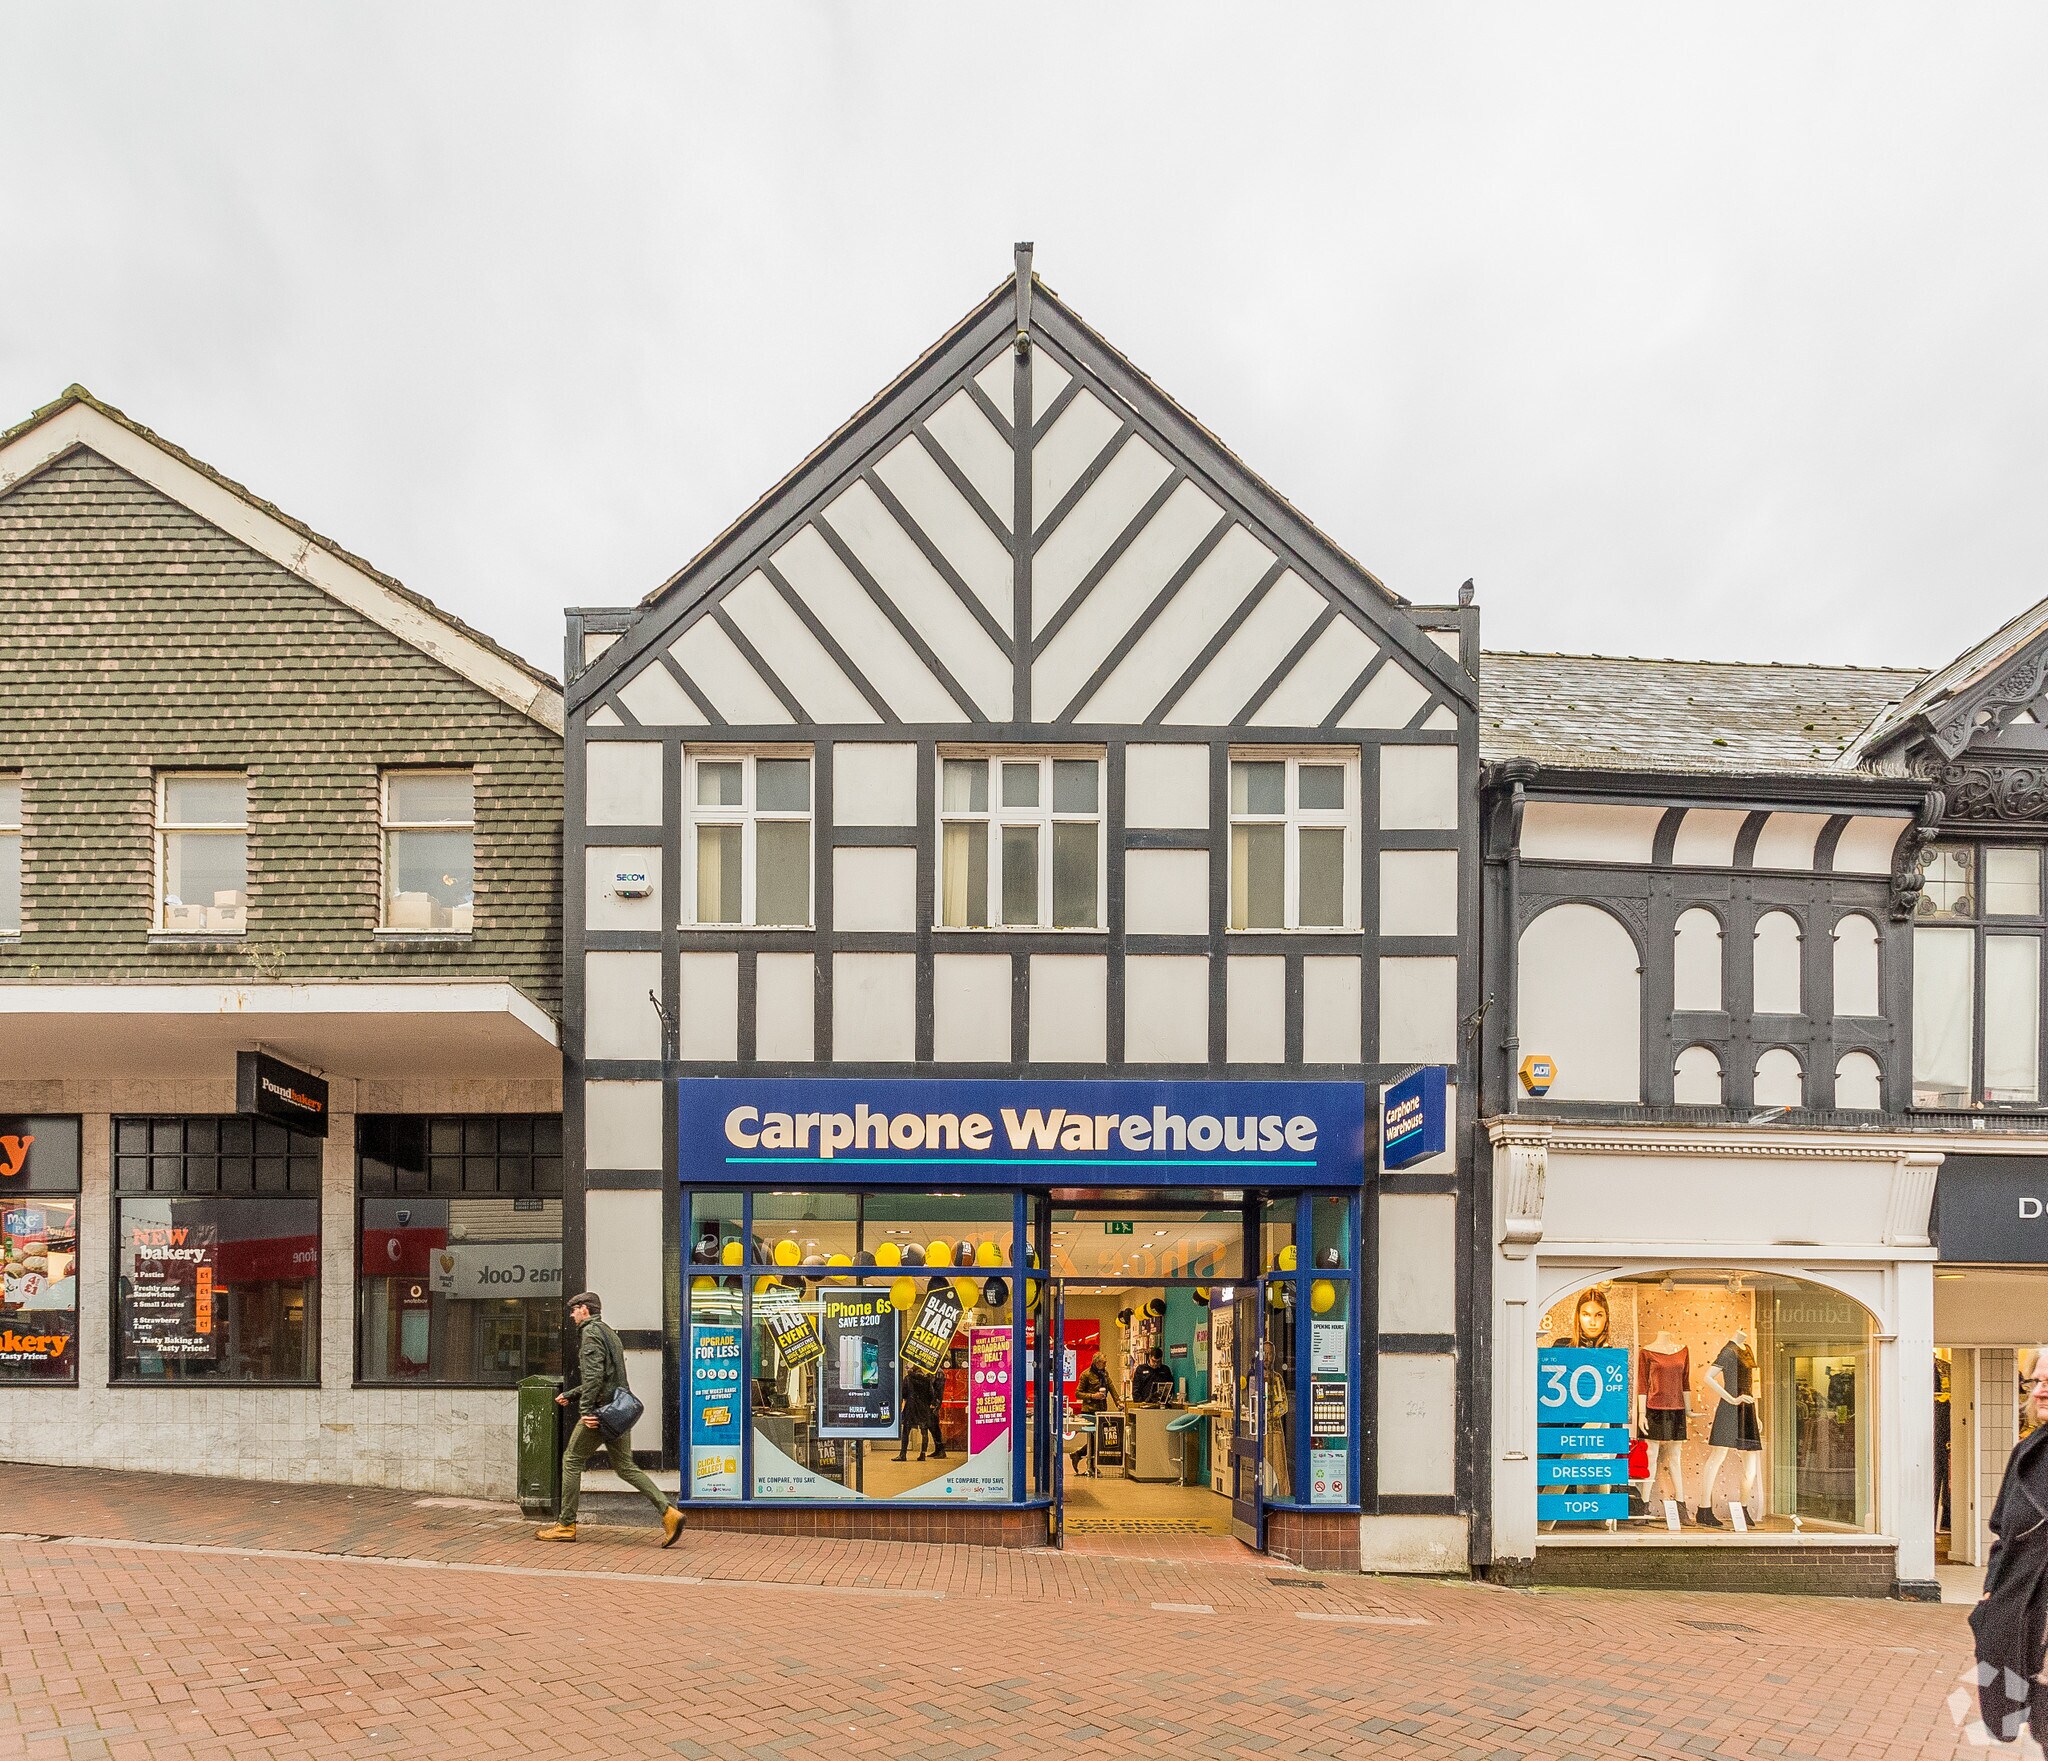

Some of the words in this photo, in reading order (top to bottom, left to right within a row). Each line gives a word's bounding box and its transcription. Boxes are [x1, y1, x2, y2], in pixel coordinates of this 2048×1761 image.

[616, 873, 645, 881] SECOM
[1533, 1066, 1550, 1075] ADT
[262, 1077, 322, 1112] Poundbakery
[1386, 1095, 1420, 1124] Carphone
[724, 1104, 994, 1158] Carphone
[999, 1106, 1317, 1151] Warehouse
[1386, 1112, 1423, 1141] Warehouse
[0, 1135, 35, 1176] y
[2019, 1197, 2048, 1218] D
[133, 1227, 189, 1246] NEW
[140, 1245, 212, 1263] bakery...
[24, 1284, 38, 1295] £1
[827, 1302, 872, 1318] iPhone
[876, 1298, 892, 1314] 6s
[927, 1296, 960, 1321] BLACK
[768, 1311, 805, 1336] TAG
[838, 1316, 858, 1328] SAVE
[920, 1307, 953, 1339] TAG
[164, 1337, 192, 1345] Baking
[700, 1336, 734, 1346] UPGRADE
[778, 1323, 810, 1348] EVENT
[913, 1326, 946, 1350] EVENT
[0, 1330, 70, 1357] kery
[157, 1345, 180, 1353] Tasty
[181, 1344, 210, 1352] Prices!
[972, 1341, 1010, 1354] BROADBAND
[695, 1346, 714, 1359] FOR
[717, 1345, 740, 1358] LESS
[984, 1352, 1003, 1363] DEAL?
[976, 1397, 984, 1406] 30
[984, 1395, 1006, 1405] SECOND
[975, 1404, 1006, 1415] CHALLENGE
[1104, 1431, 1118, 1440] TAG
[1560, 1435, 1605, 1446] PETITE
[817, 1439, 834, 1448] BLACK
[818, 1447, 836, 1458] TAG
[697, 1457, 714, 1468] CLICK
[715, 1455, 721, 1463] &
[819, 1457, 836, 1466] EVENT
[696, 1463, 722, 1477] COLLECT
[1552, 1466, 1612, 1478] DRESSES
[1564, 1501, 1599, 1512] TOPS
